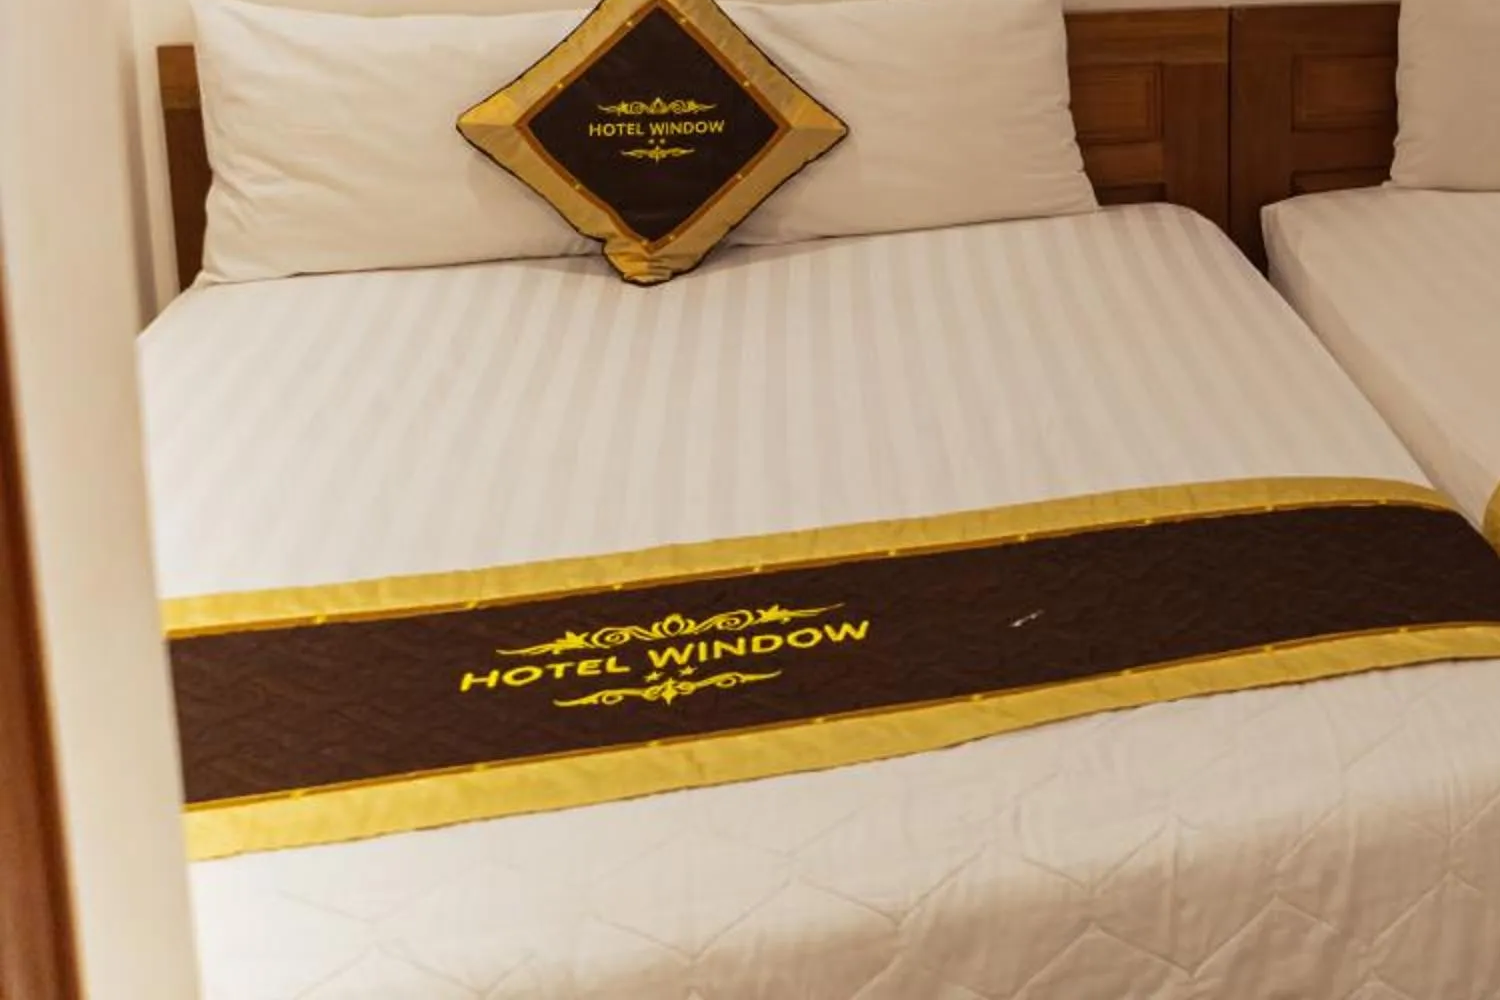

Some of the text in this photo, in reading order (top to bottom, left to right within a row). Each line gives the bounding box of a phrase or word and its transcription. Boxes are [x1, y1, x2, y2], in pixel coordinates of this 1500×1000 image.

[589, 120, 725, 137] HOTEL WINDOW
[459, 620, 870, 691] HOTEL WINDOW
